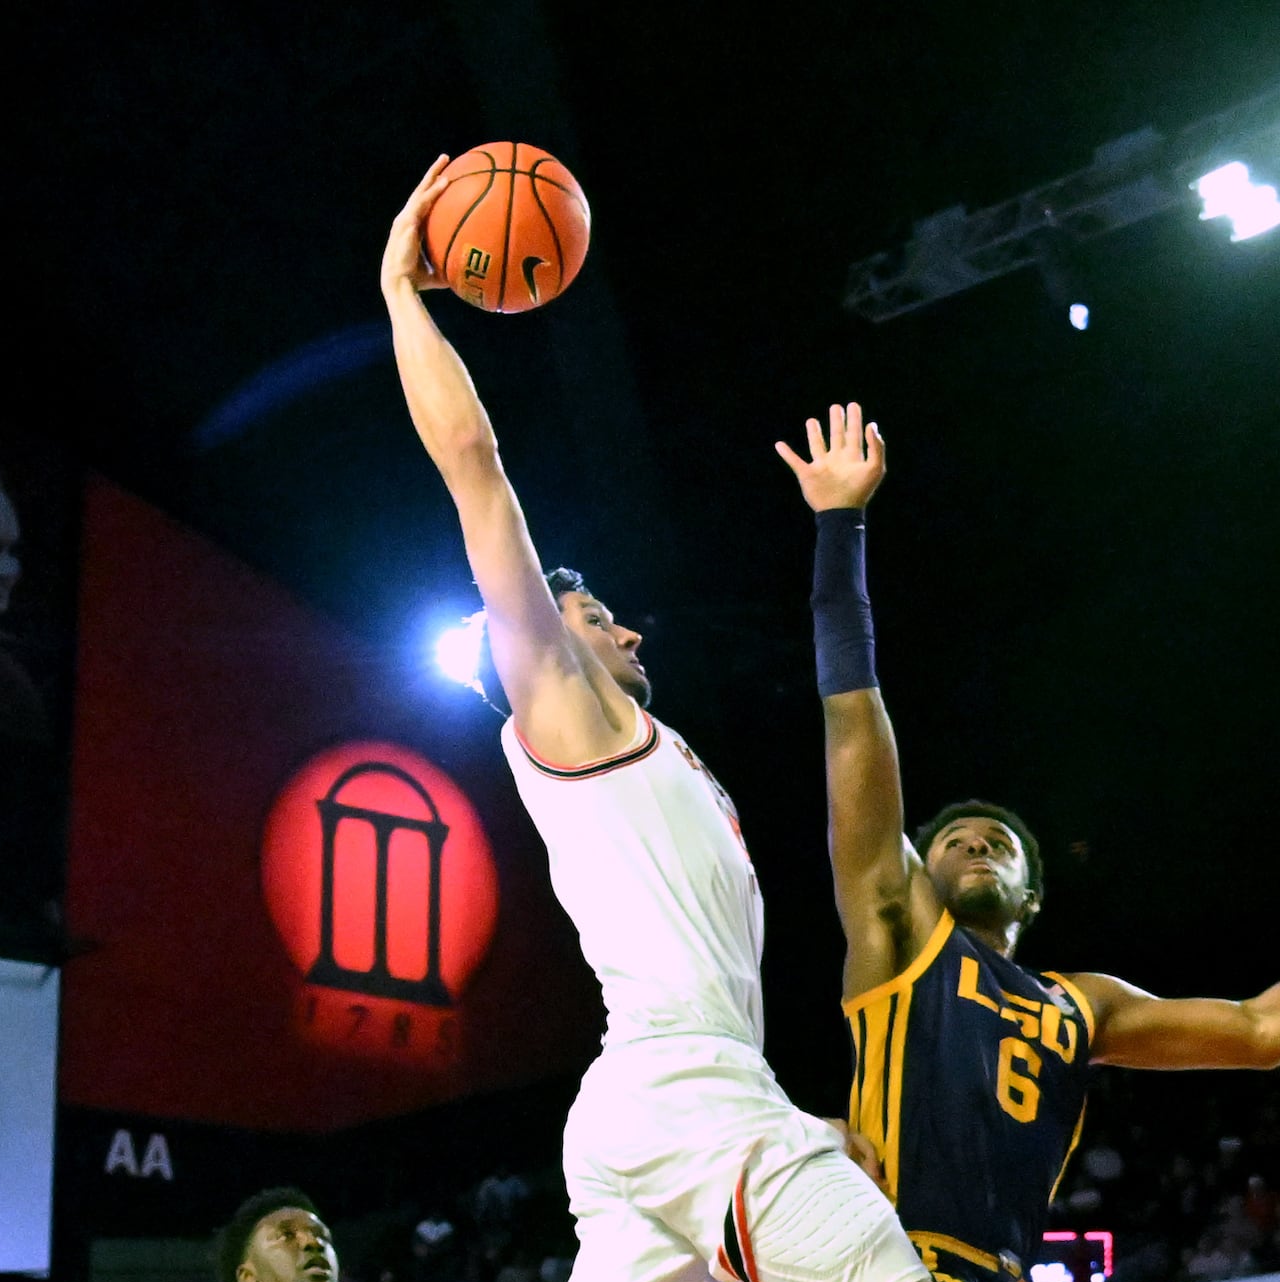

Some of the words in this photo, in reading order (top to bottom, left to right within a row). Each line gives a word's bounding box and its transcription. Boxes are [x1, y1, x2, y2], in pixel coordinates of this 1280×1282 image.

[957, 956, 1078, 1065] LSU
[996, 1036, 1042, 1124] 6
[104, 1129, 173, 1180] AA
